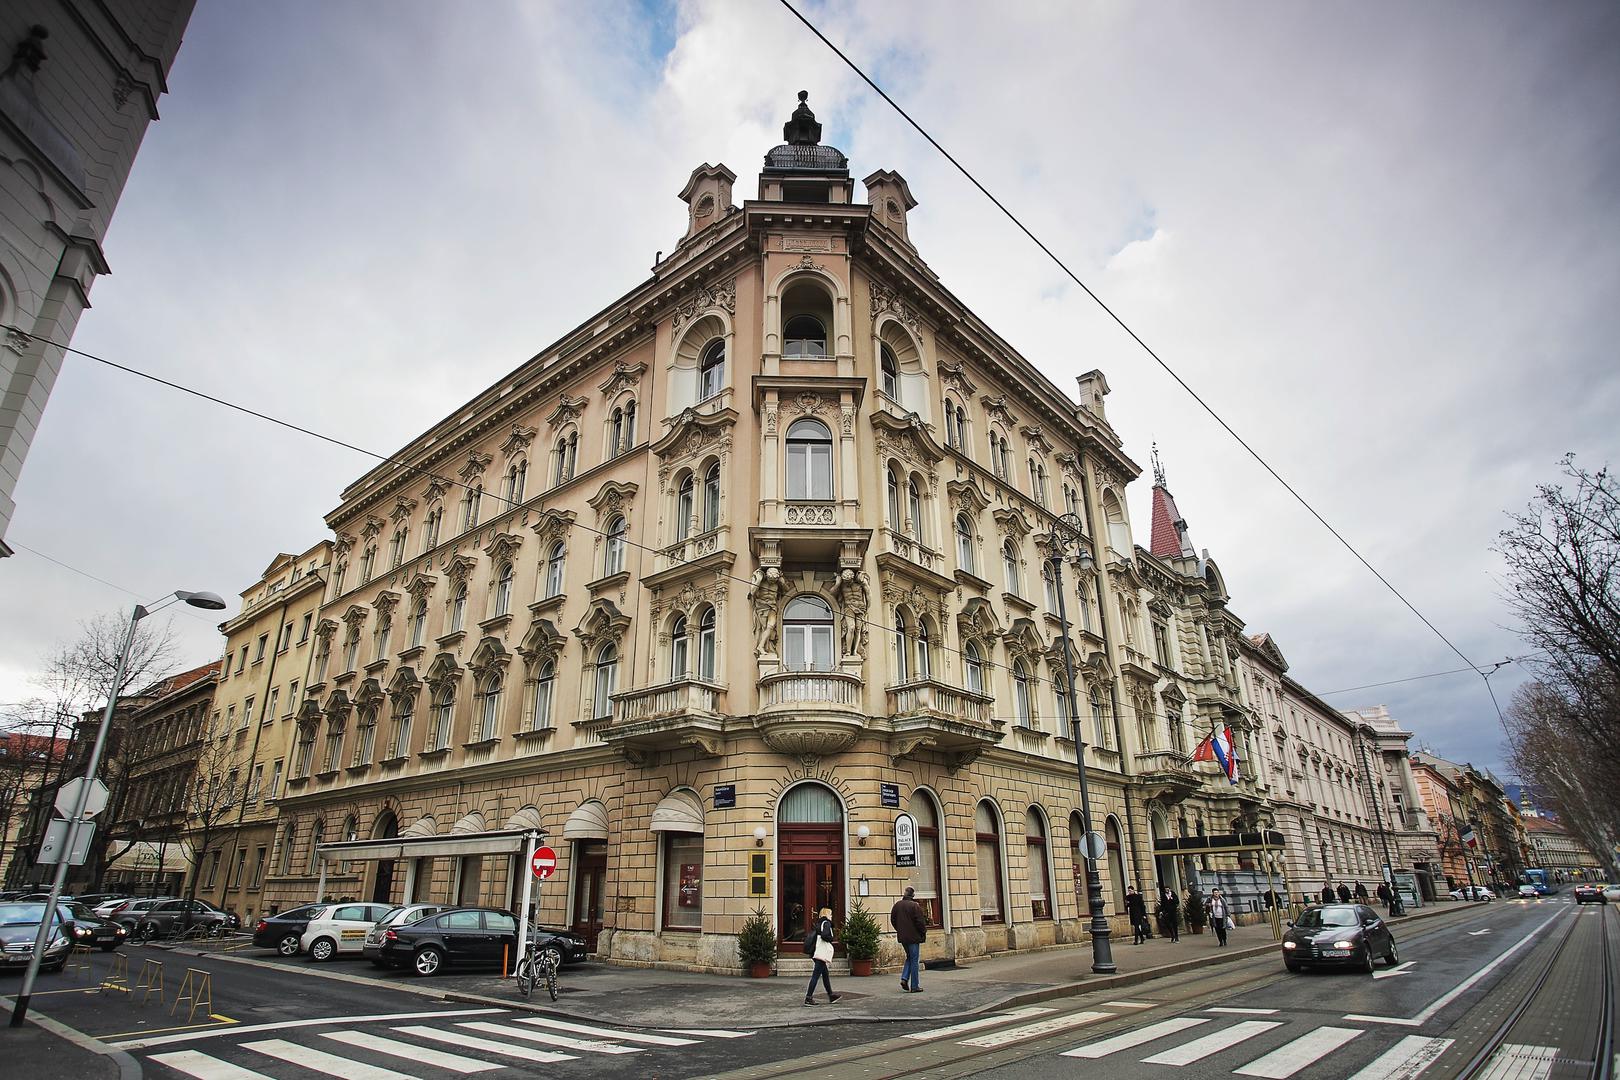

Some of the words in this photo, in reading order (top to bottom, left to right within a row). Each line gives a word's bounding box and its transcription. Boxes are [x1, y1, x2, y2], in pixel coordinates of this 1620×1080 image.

[955, 461, 1027, 521] PALACE
[390, 544, 459, 589] PALACE
[763, 767, 813, 819] PALACE
[820, 769, 859, 820] HOTEL
